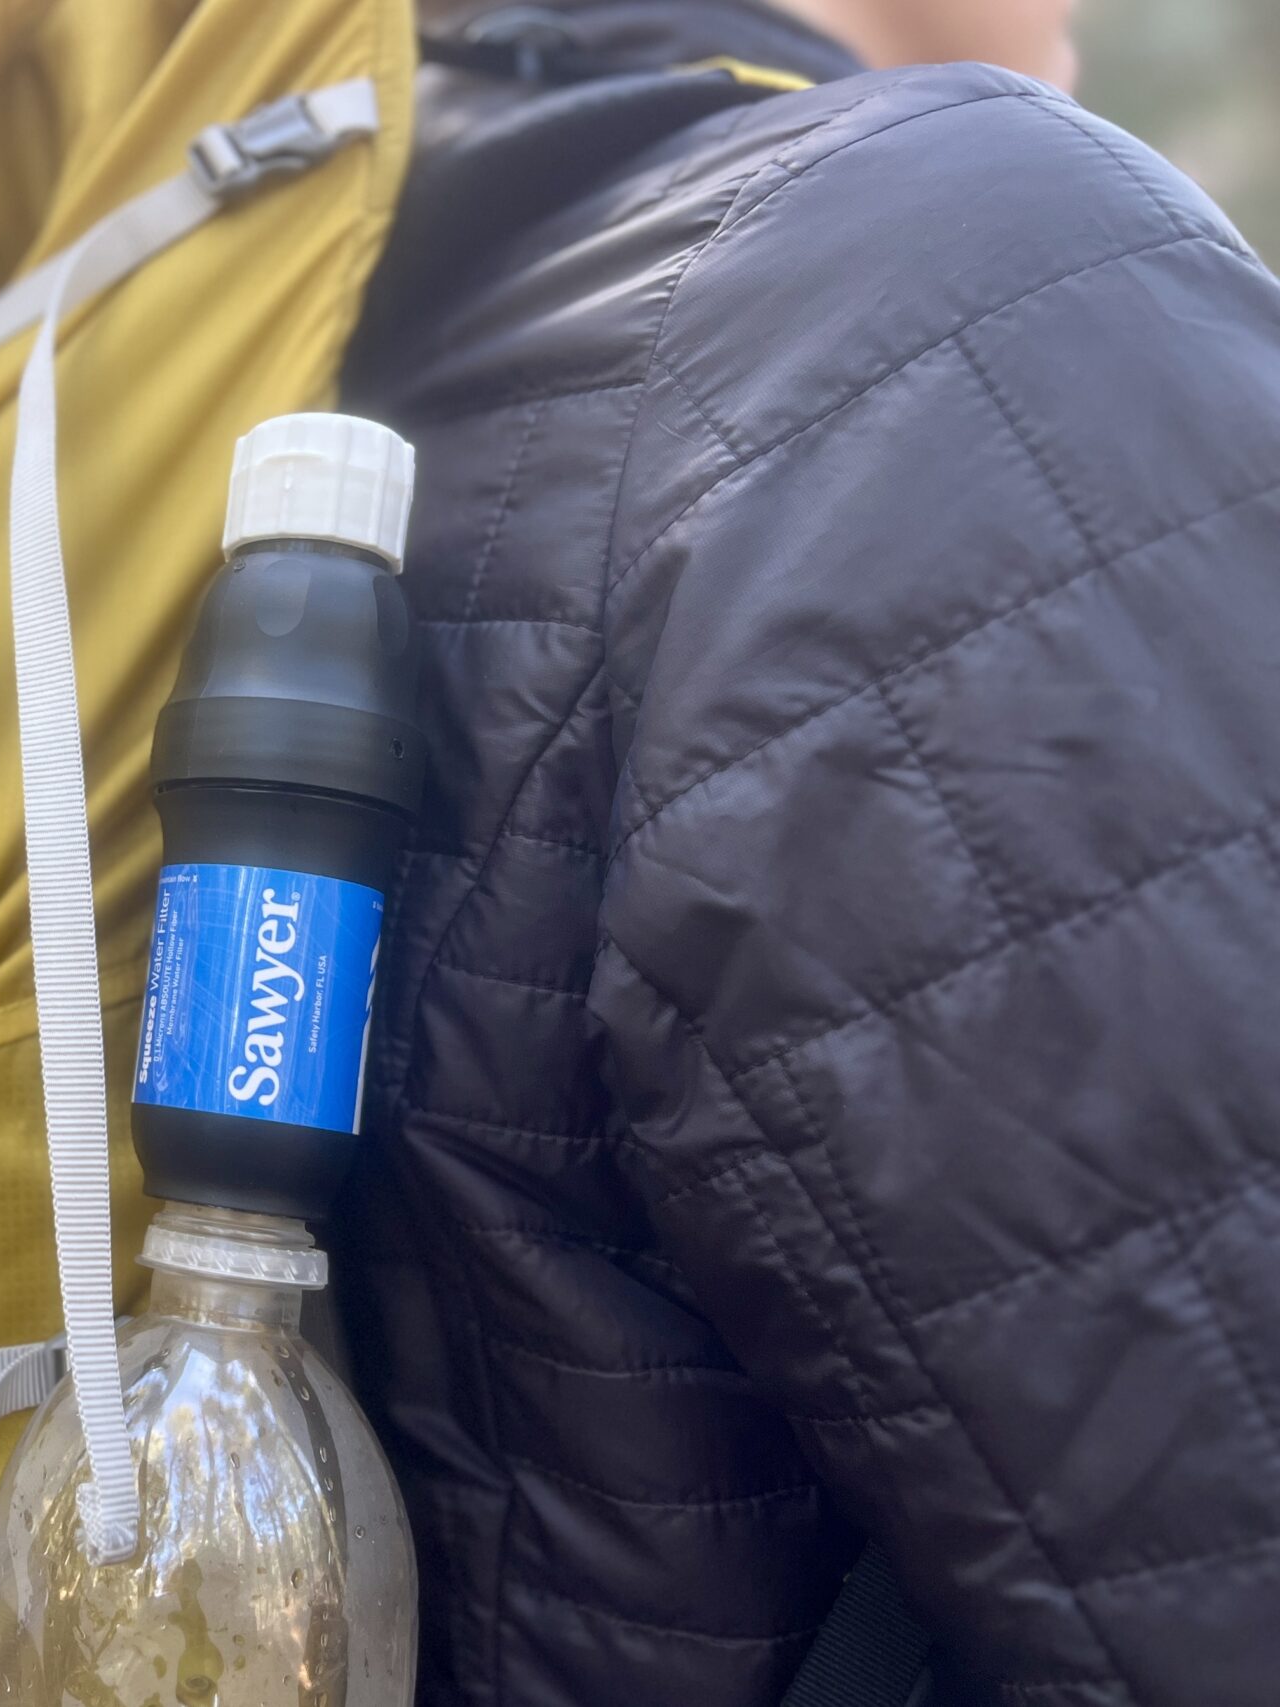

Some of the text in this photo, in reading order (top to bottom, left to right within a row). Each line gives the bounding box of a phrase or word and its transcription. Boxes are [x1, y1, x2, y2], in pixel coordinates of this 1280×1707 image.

[170, 910, 178, 932] Fiber
[166, 933, 176, 964] Hollow
[318, 955, 327, 974] USA
[139, 995, 157, 1084] Squeeze
[149, 937, 165, 991] Water
[157, 888, 170, 934] Filter
[160, 965, 172, 1012] ABSOLUTE
[166, 937, 184, 1035] Membrane Water Filter
[228, 887, 305, 1106] Sawyer
[315, 976, 324, 988] FL
[308, 1024, 320, 1054] Safety
